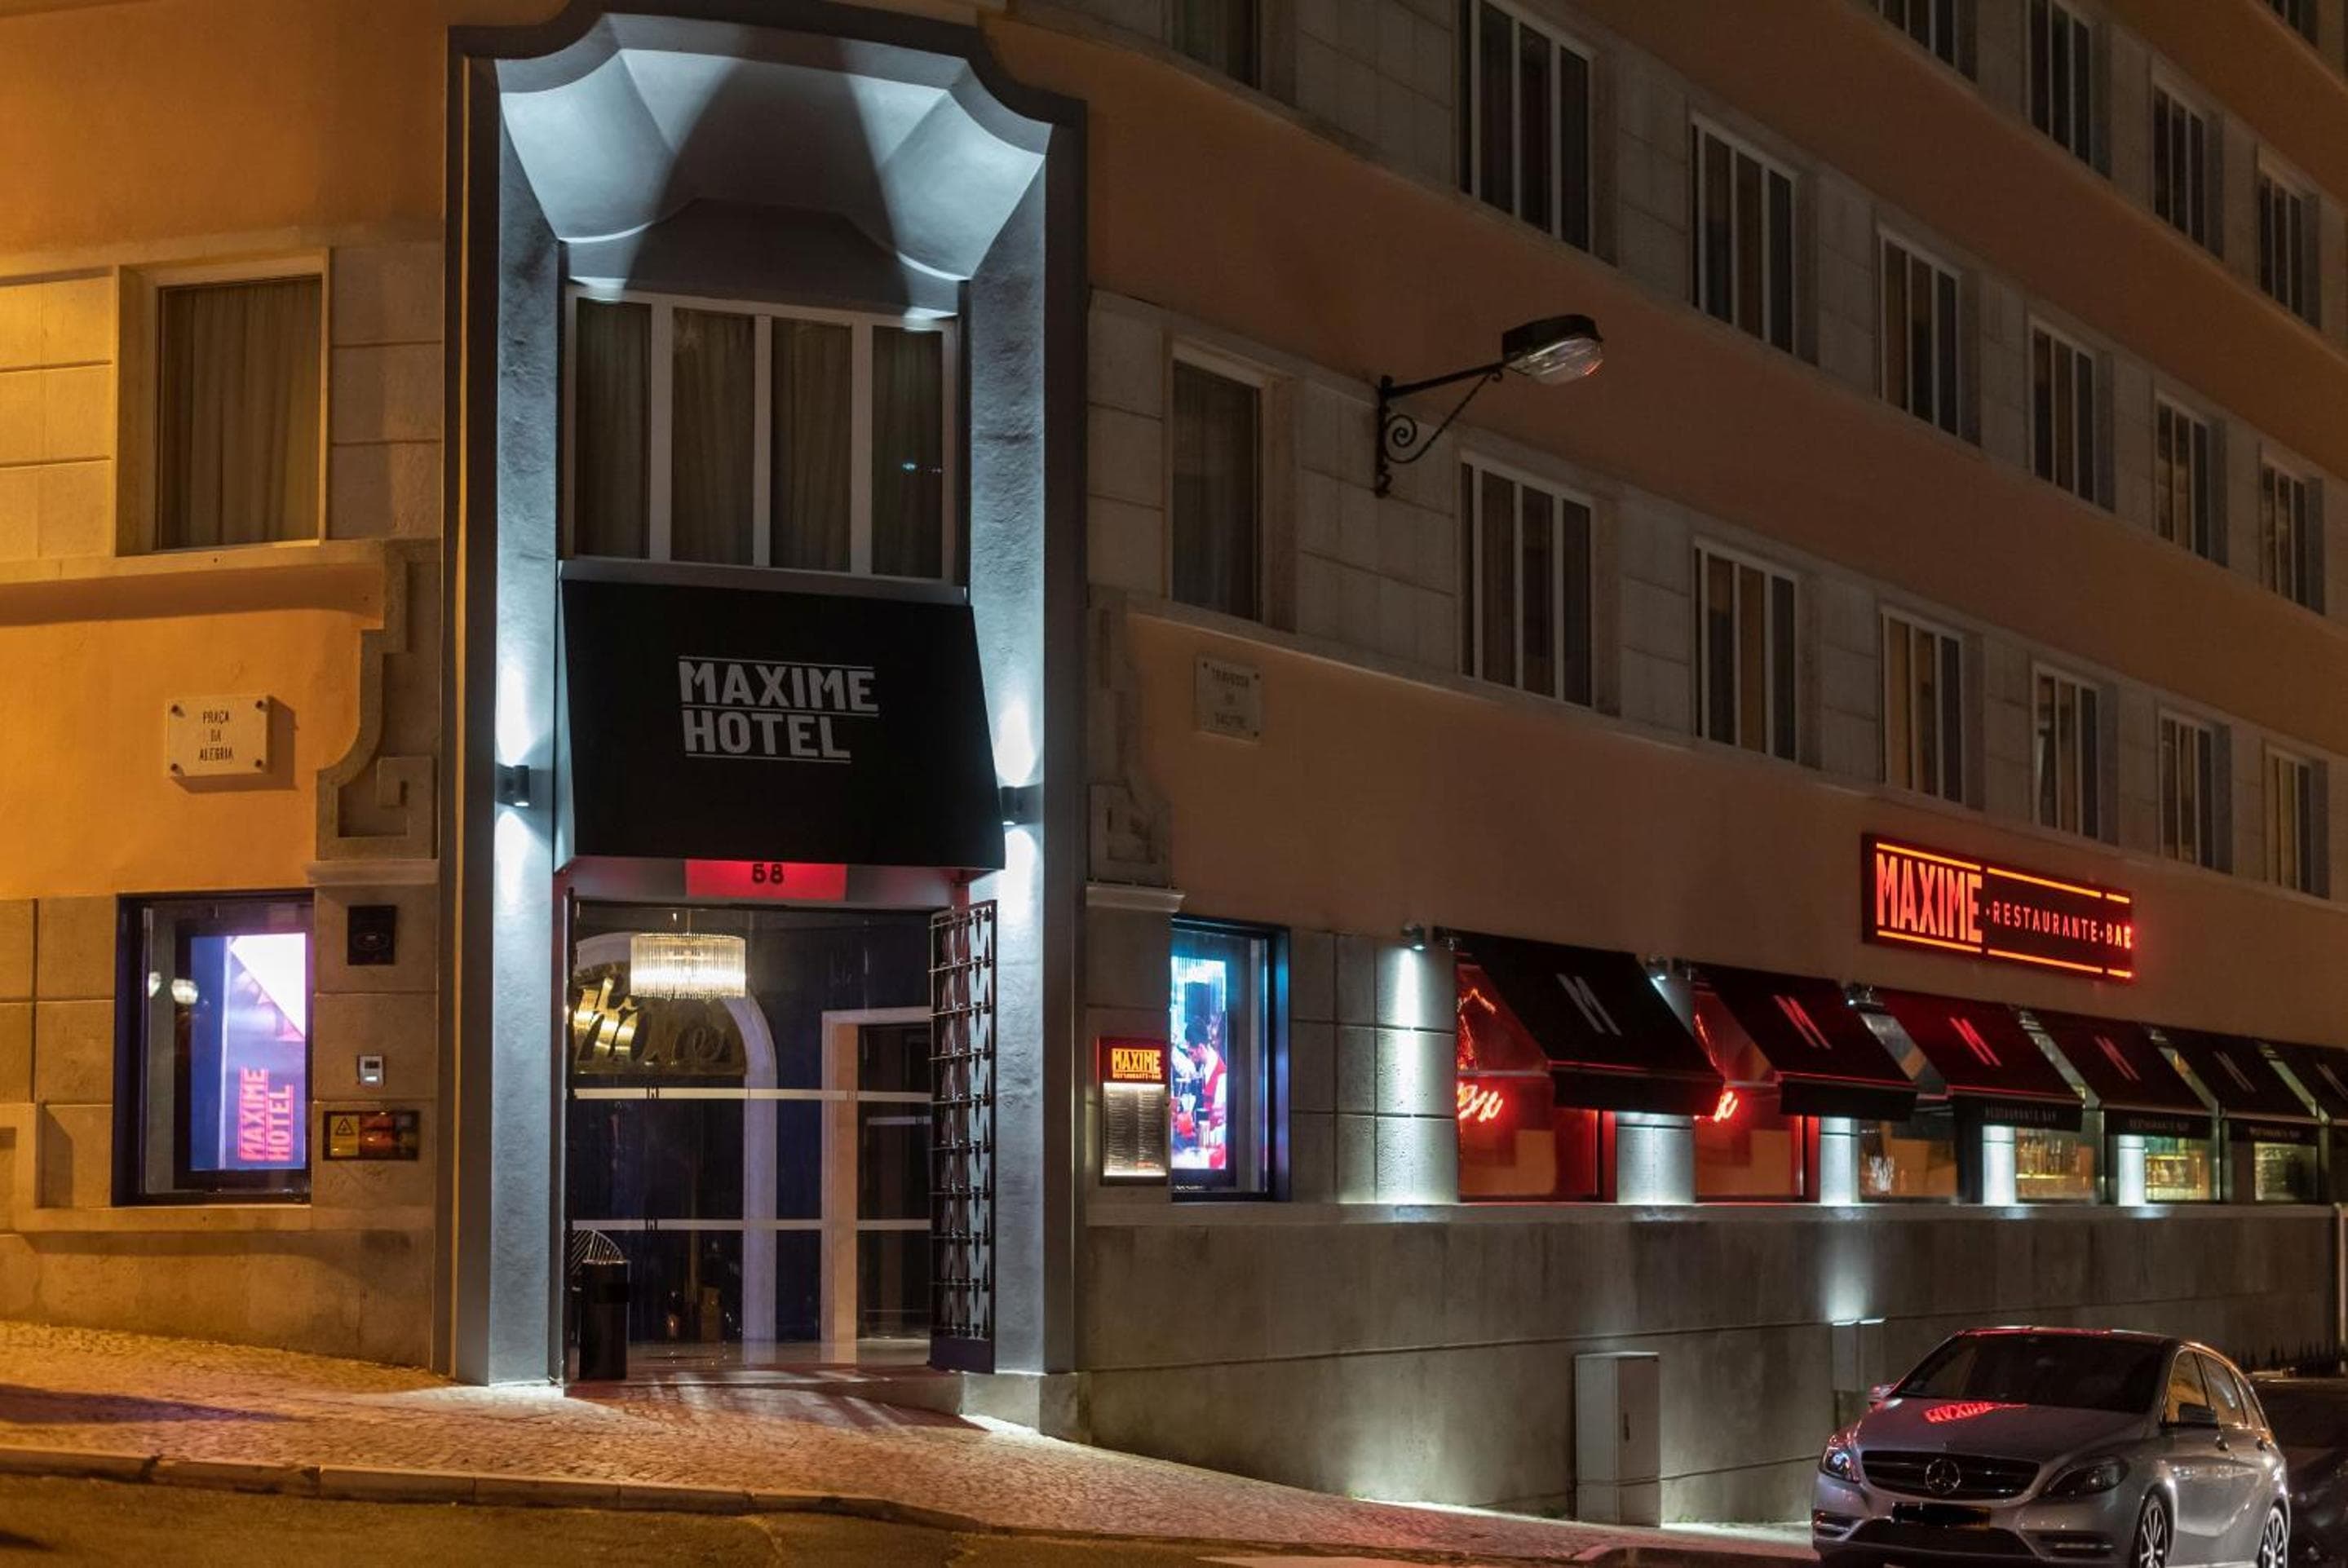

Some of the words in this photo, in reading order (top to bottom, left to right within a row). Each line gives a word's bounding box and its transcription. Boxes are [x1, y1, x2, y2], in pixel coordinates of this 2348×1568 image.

[679, 660, 879, 713] MAXIME
[201, 710, 229, 725] PRAÇA
[682, 709, 851, 758] HOTEL
[200, 747, 233, 762] ALEGRIA
[751, 863, 785, 884] 58
[1877, 853, 1983, 943] MAXIME
[1992, 900, 2098, 943] RESTAURANTE
[2106, 914, 2133, 950] BAR
[1112, 1049, 1161, 1072] MAXIME
[242, 1067, 267, 1161] MAXIME
[268, 1084, 291, 1161] HOTEL
